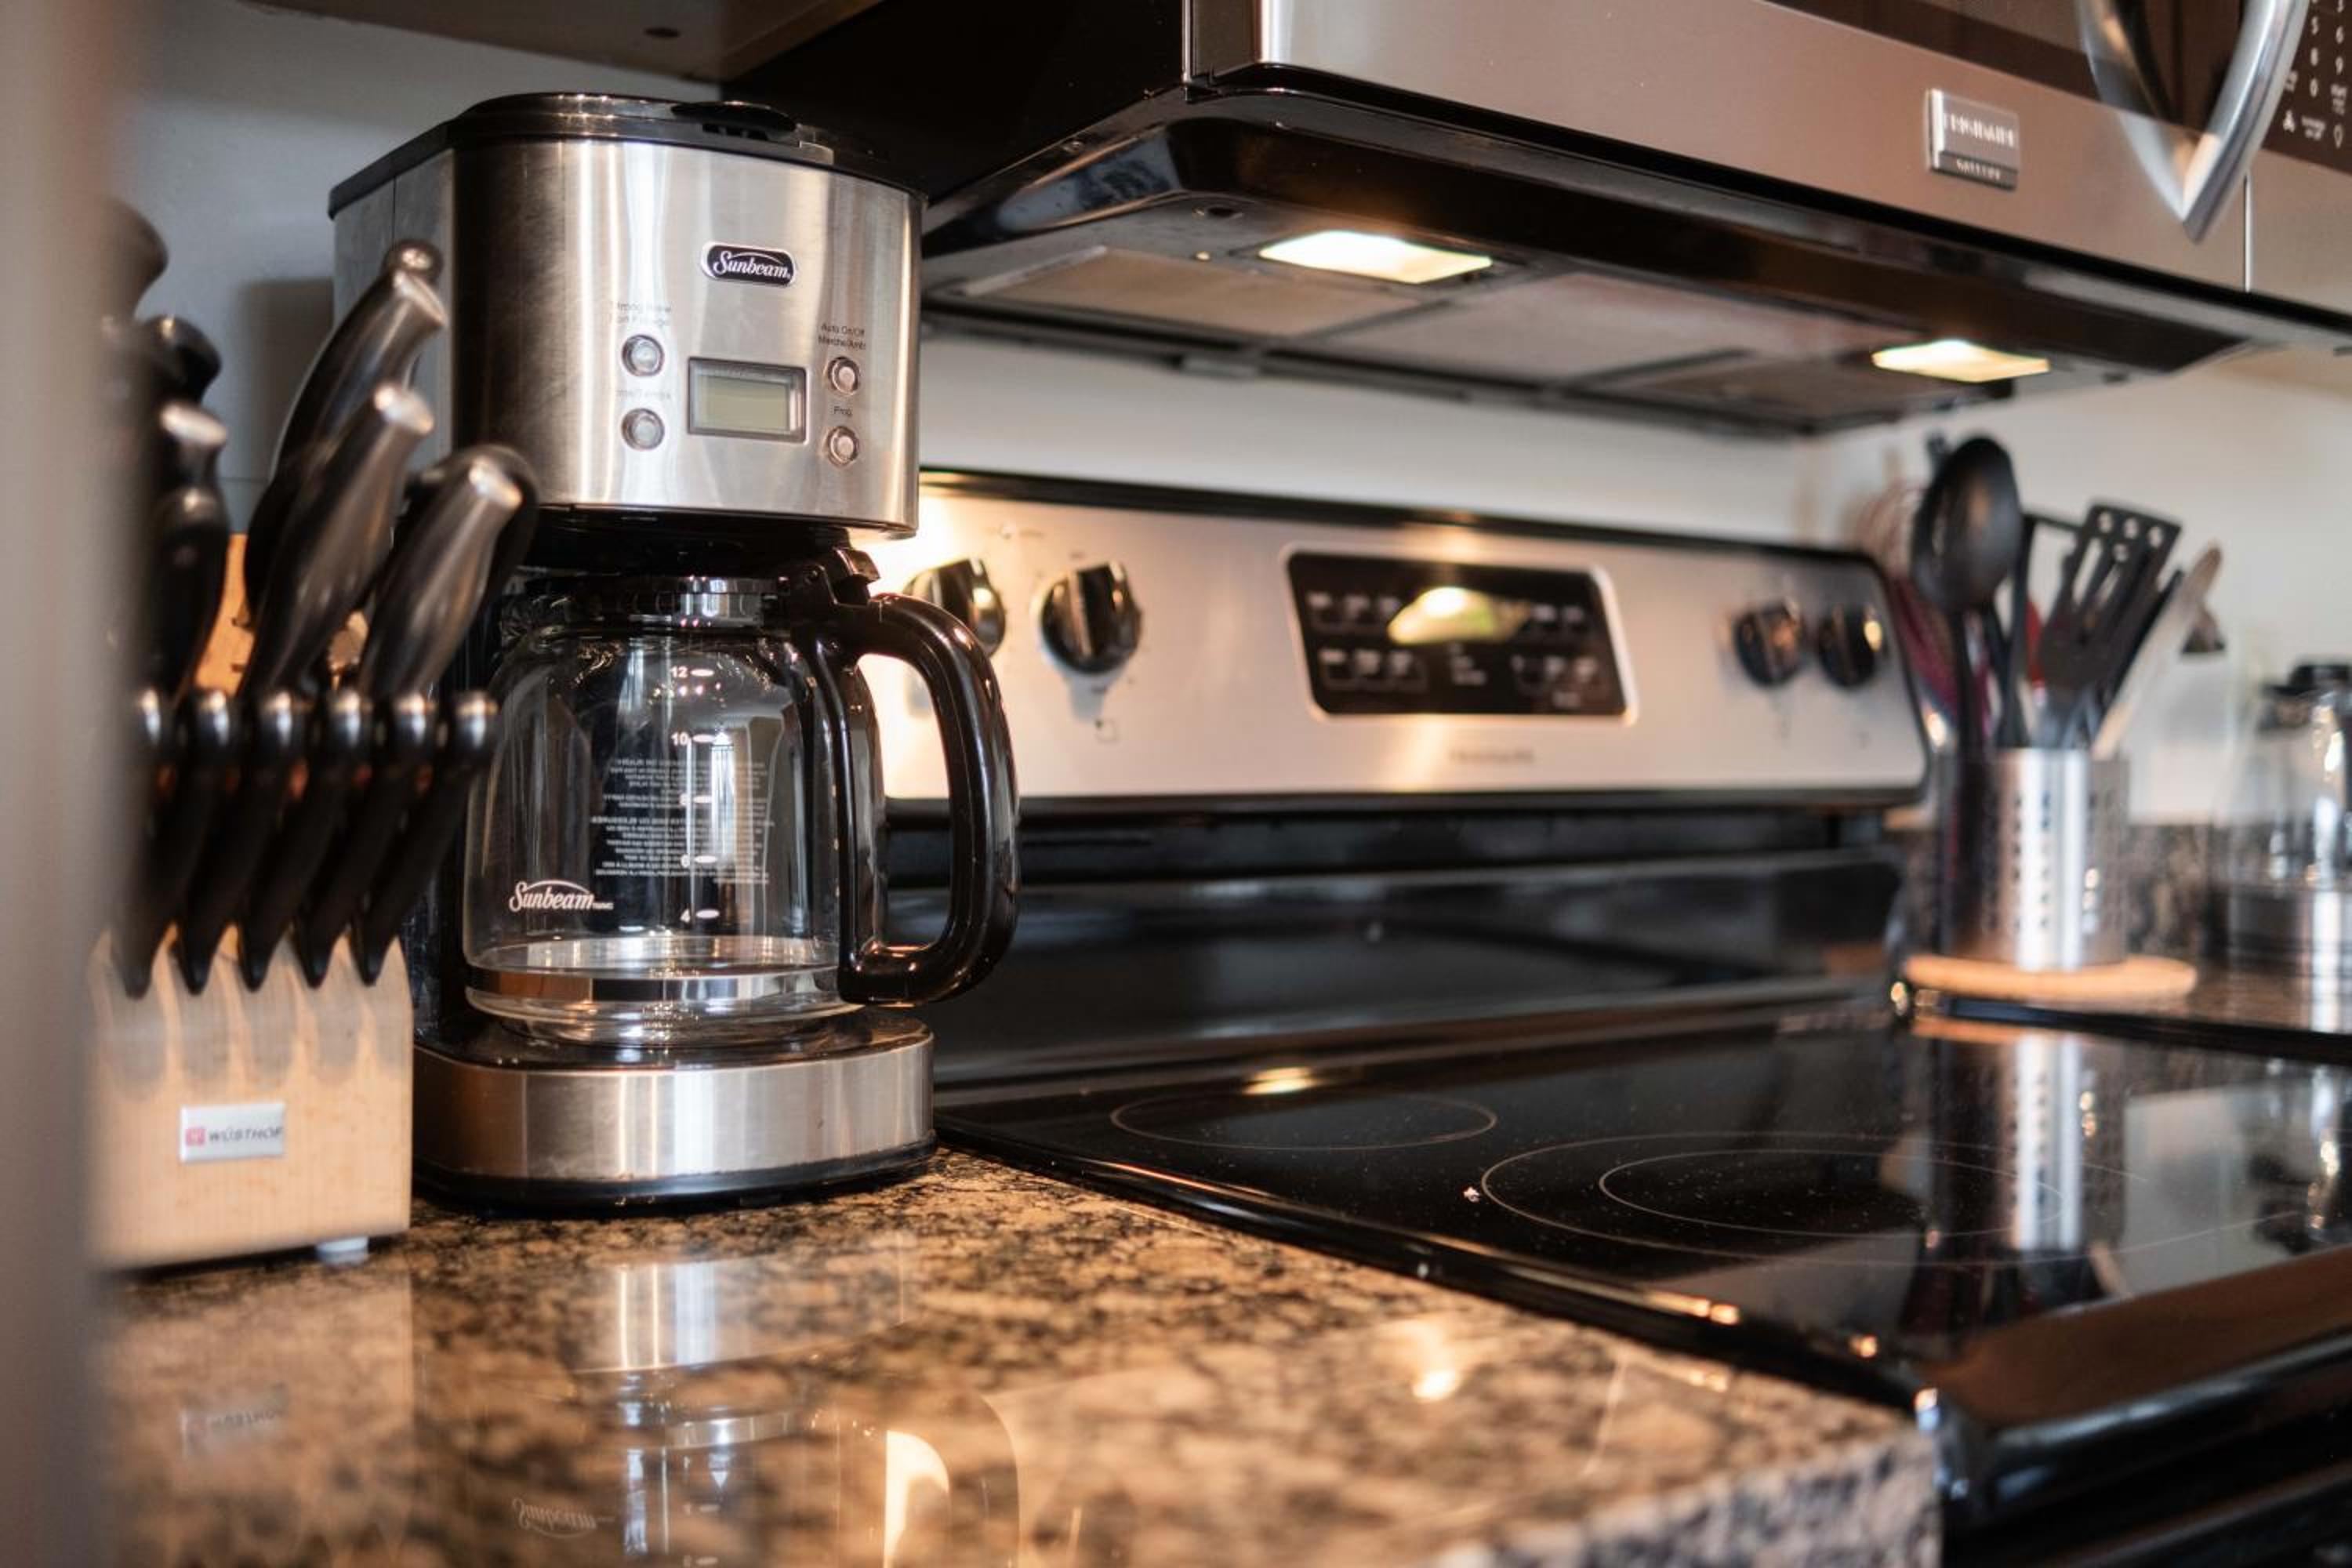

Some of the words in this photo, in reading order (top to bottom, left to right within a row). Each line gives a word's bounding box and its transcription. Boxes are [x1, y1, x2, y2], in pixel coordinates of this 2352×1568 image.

[713, 250, 789, 278] Sunbeam
[671, 666, 688, 678] 12
[671, 731, 690, 746] 10
[509, 880, 594, 913] Sunbeam
[680, 908, 691, 924] 4
